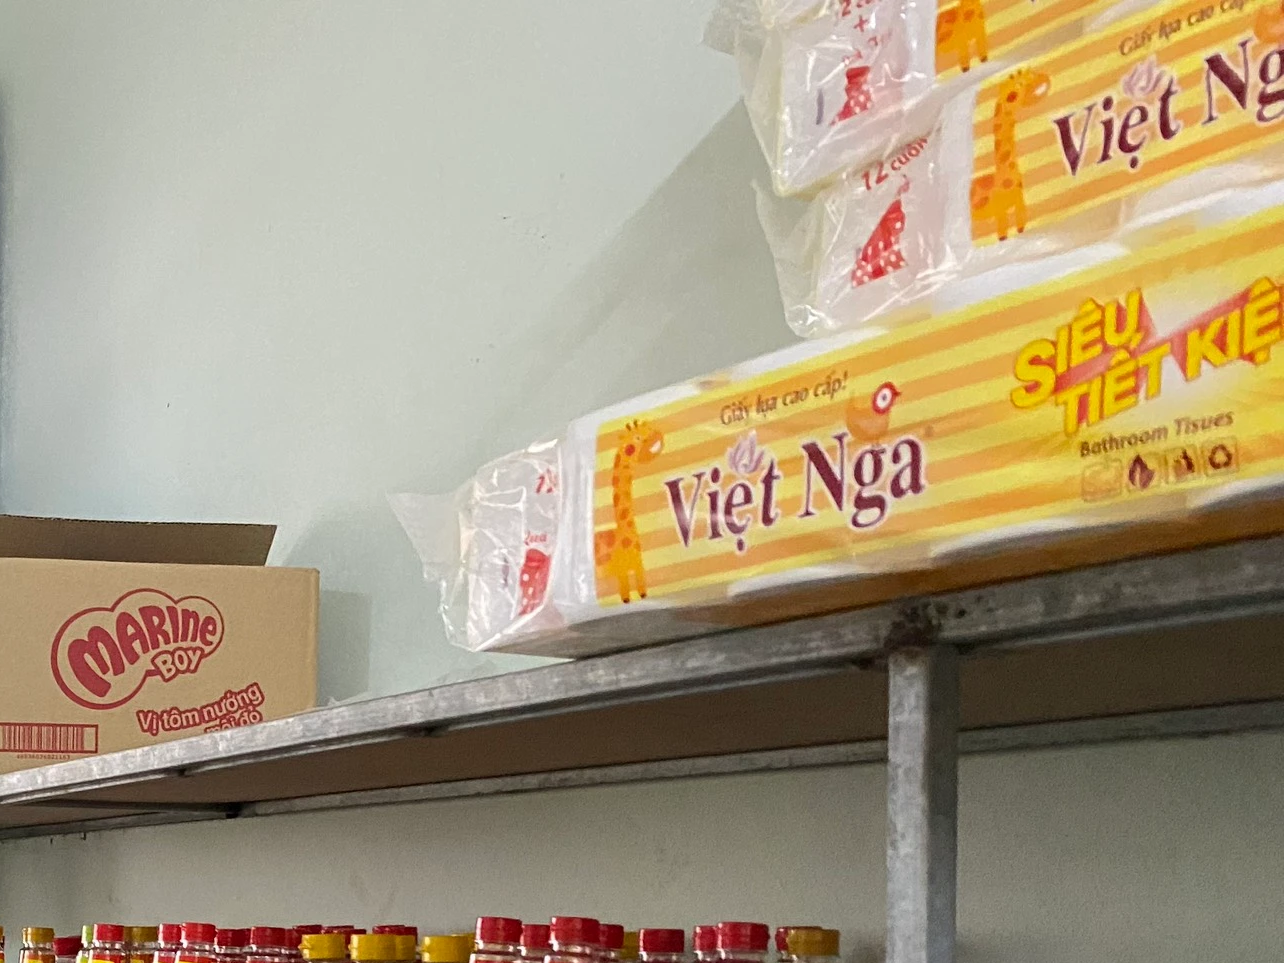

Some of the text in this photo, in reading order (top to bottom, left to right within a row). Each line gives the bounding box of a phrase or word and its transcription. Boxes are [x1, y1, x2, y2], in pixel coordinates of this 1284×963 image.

[1053, 76, 1181, 177] Việt
[1010, 287, 1142, 408] SIÊU
[1186, 276, 1284, 382] KIỆ
[782, 386, 810, 406] cao
[1080, 411, 1235, 457] Bathroom Tisues
[665, 432, 926, 552] Việt Nga
[153, 650, 203, 680] BOY
[137, 712, 159, 737] Vị
[162, 706, 201, 732] tôm
[202, 683, 264, 718] nướng
